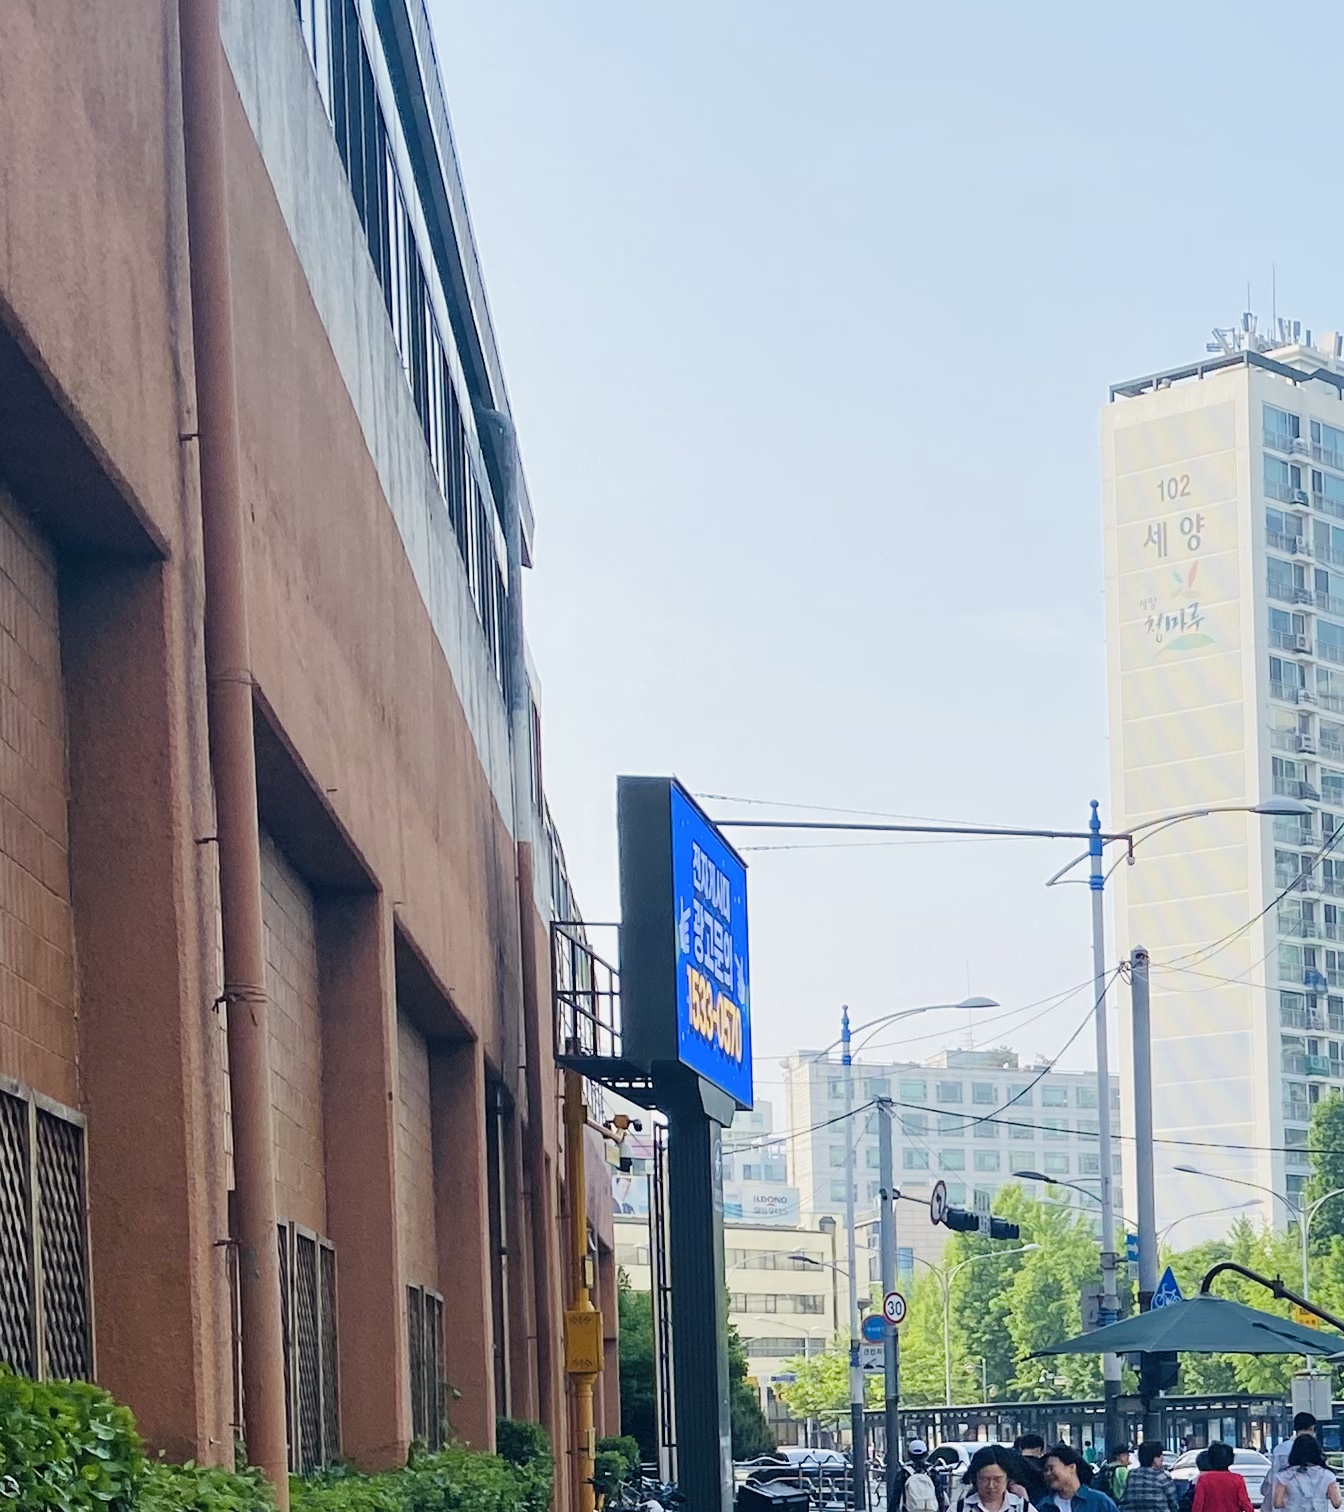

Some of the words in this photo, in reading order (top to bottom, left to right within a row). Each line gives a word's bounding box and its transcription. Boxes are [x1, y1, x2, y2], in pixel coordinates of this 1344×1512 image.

[1157, 474, 1191, 502] 102
[1143, 513, 1205, 558] 세양
[1144, 602, 1205, 643] 청마루
[692, 898, 734, 991] 광고문의
[686, 963, 743, 1064] 1533-0570
[887, 1301, 902, 1316] 30
